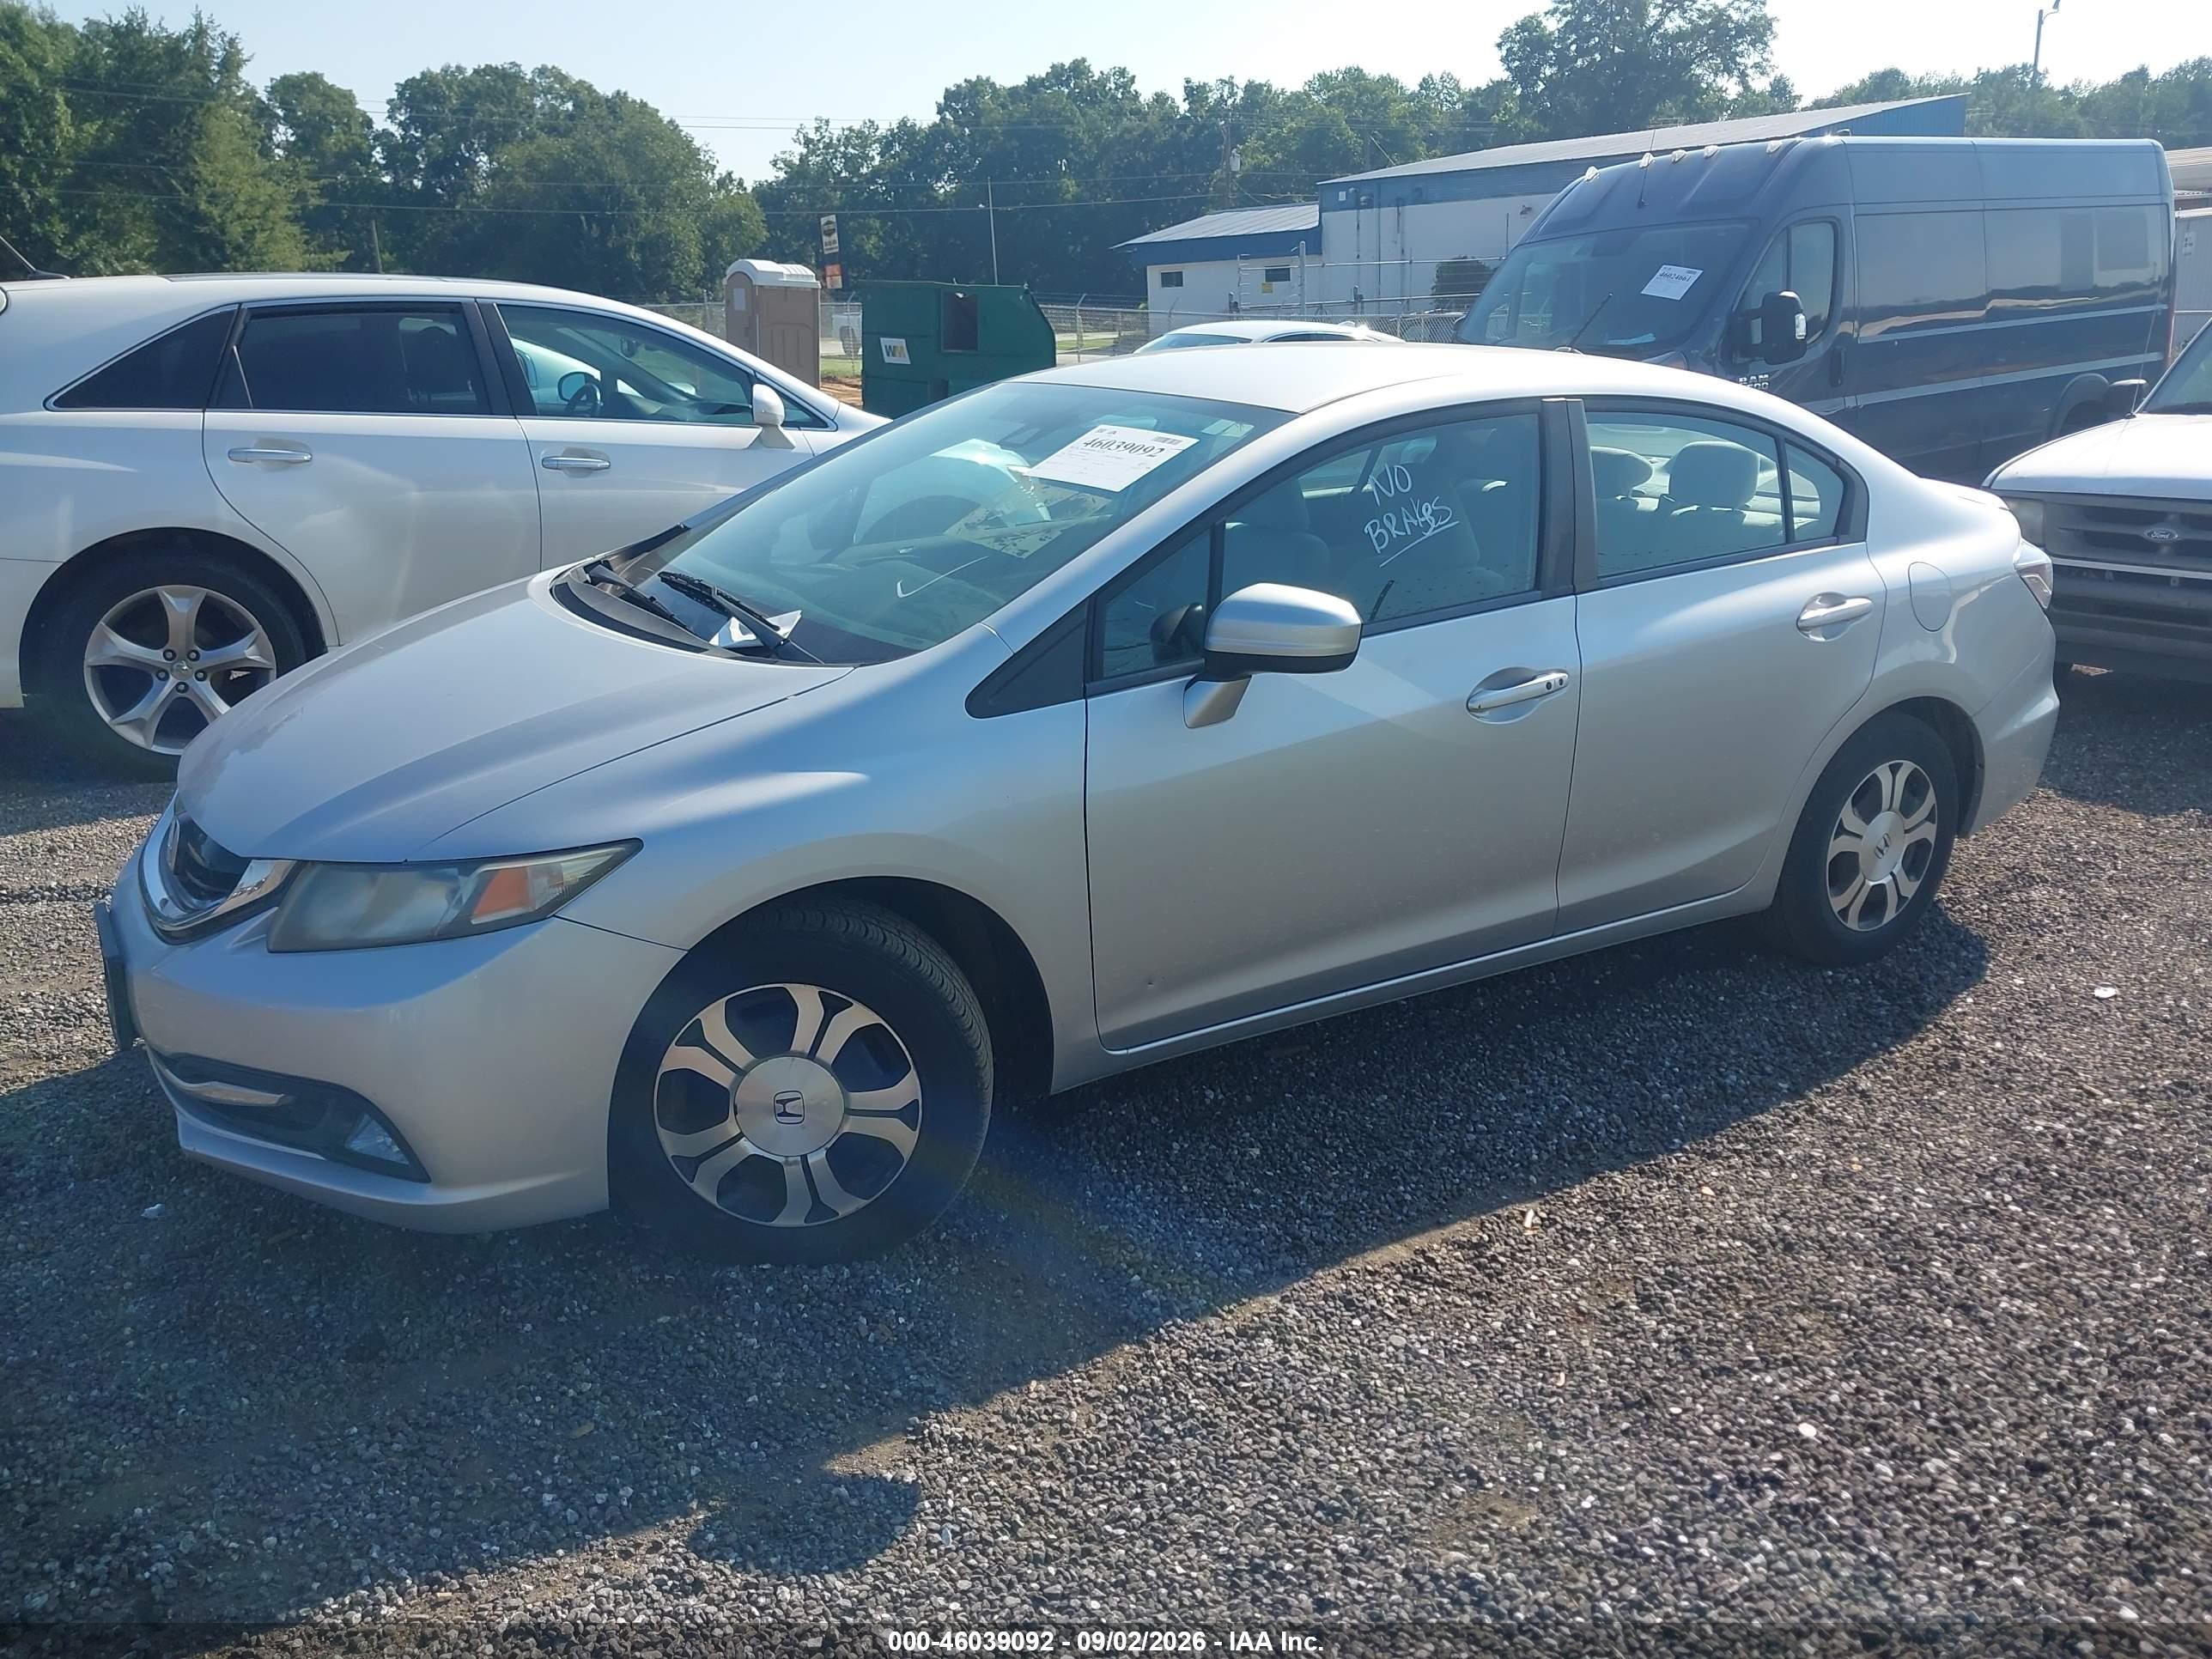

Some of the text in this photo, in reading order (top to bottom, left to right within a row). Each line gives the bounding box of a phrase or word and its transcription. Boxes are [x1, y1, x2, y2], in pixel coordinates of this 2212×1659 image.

[1739, 374, 1769, 384] RAM
[1083, 436, 1166, 458] 46039092
[1369, 464, 1413, 507] NO
[2149, 530, 2172, 539] Ford
